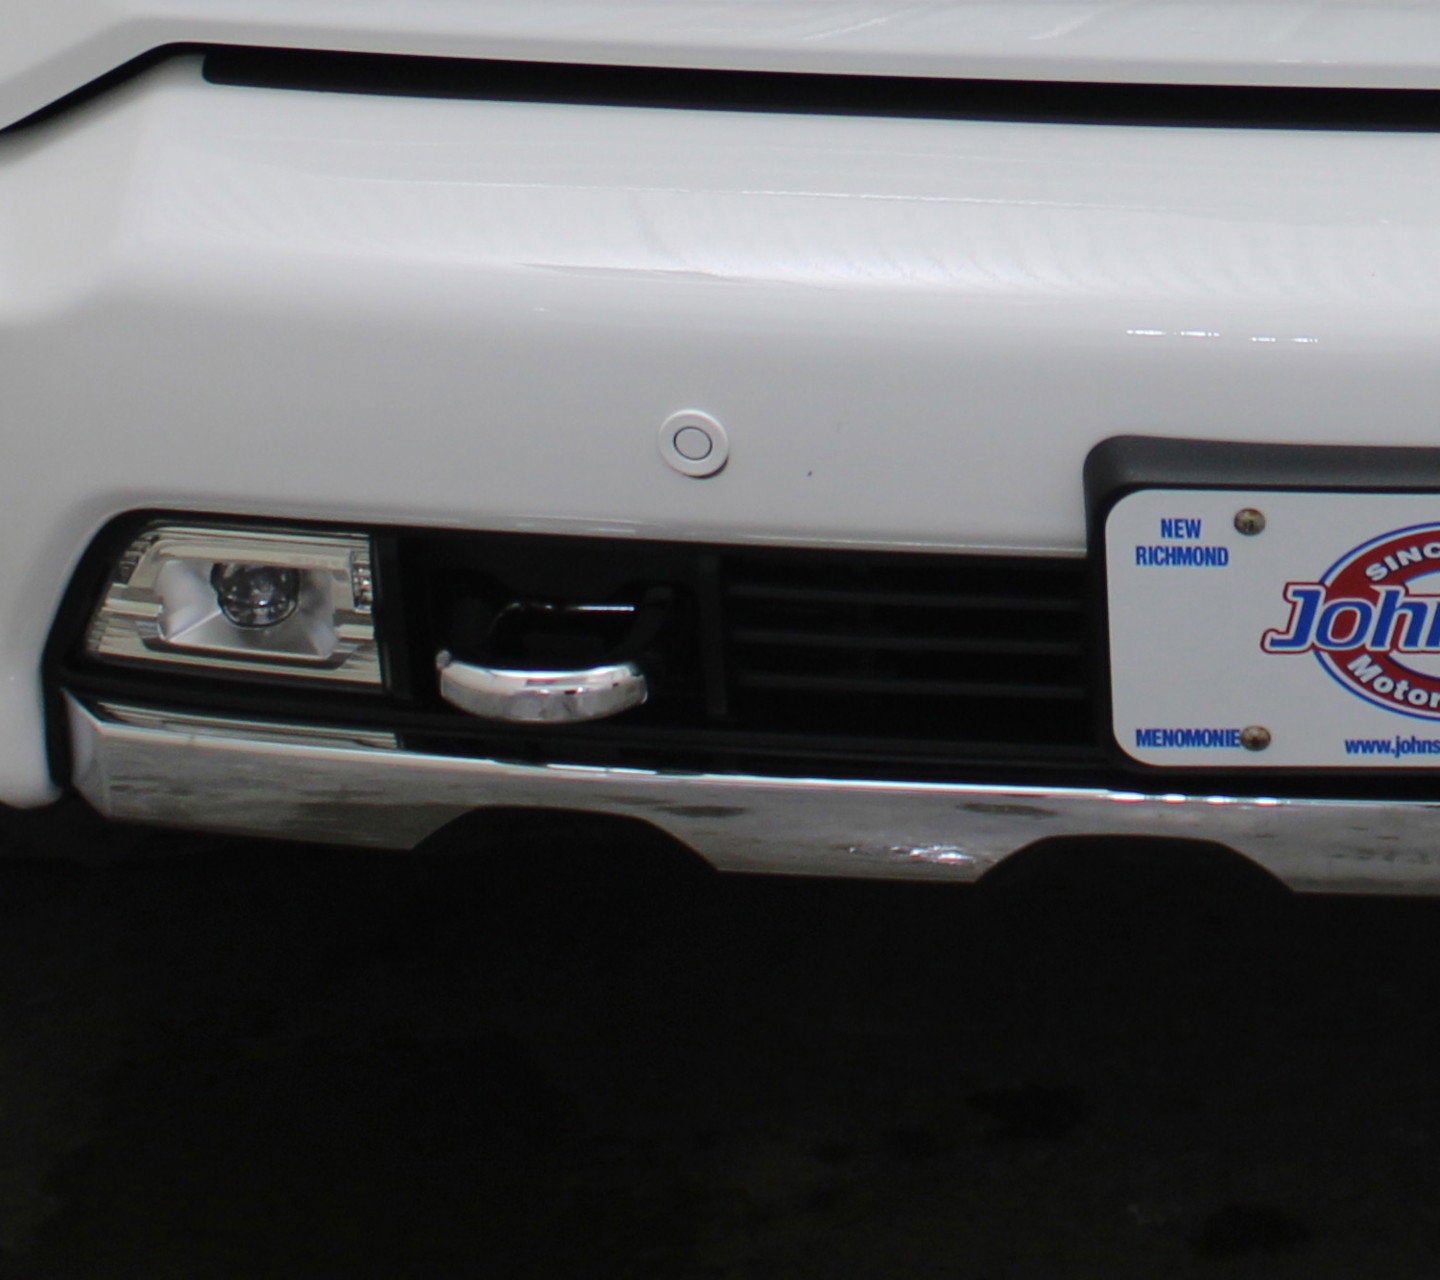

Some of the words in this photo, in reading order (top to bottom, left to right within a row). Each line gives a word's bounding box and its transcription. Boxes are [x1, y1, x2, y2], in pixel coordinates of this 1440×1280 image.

[1160, 518, 1202, 540] NEW
[1135, 545, 1229, 568] RICHMOND
[1135, 727, 1242, 749] MENOMONIE
